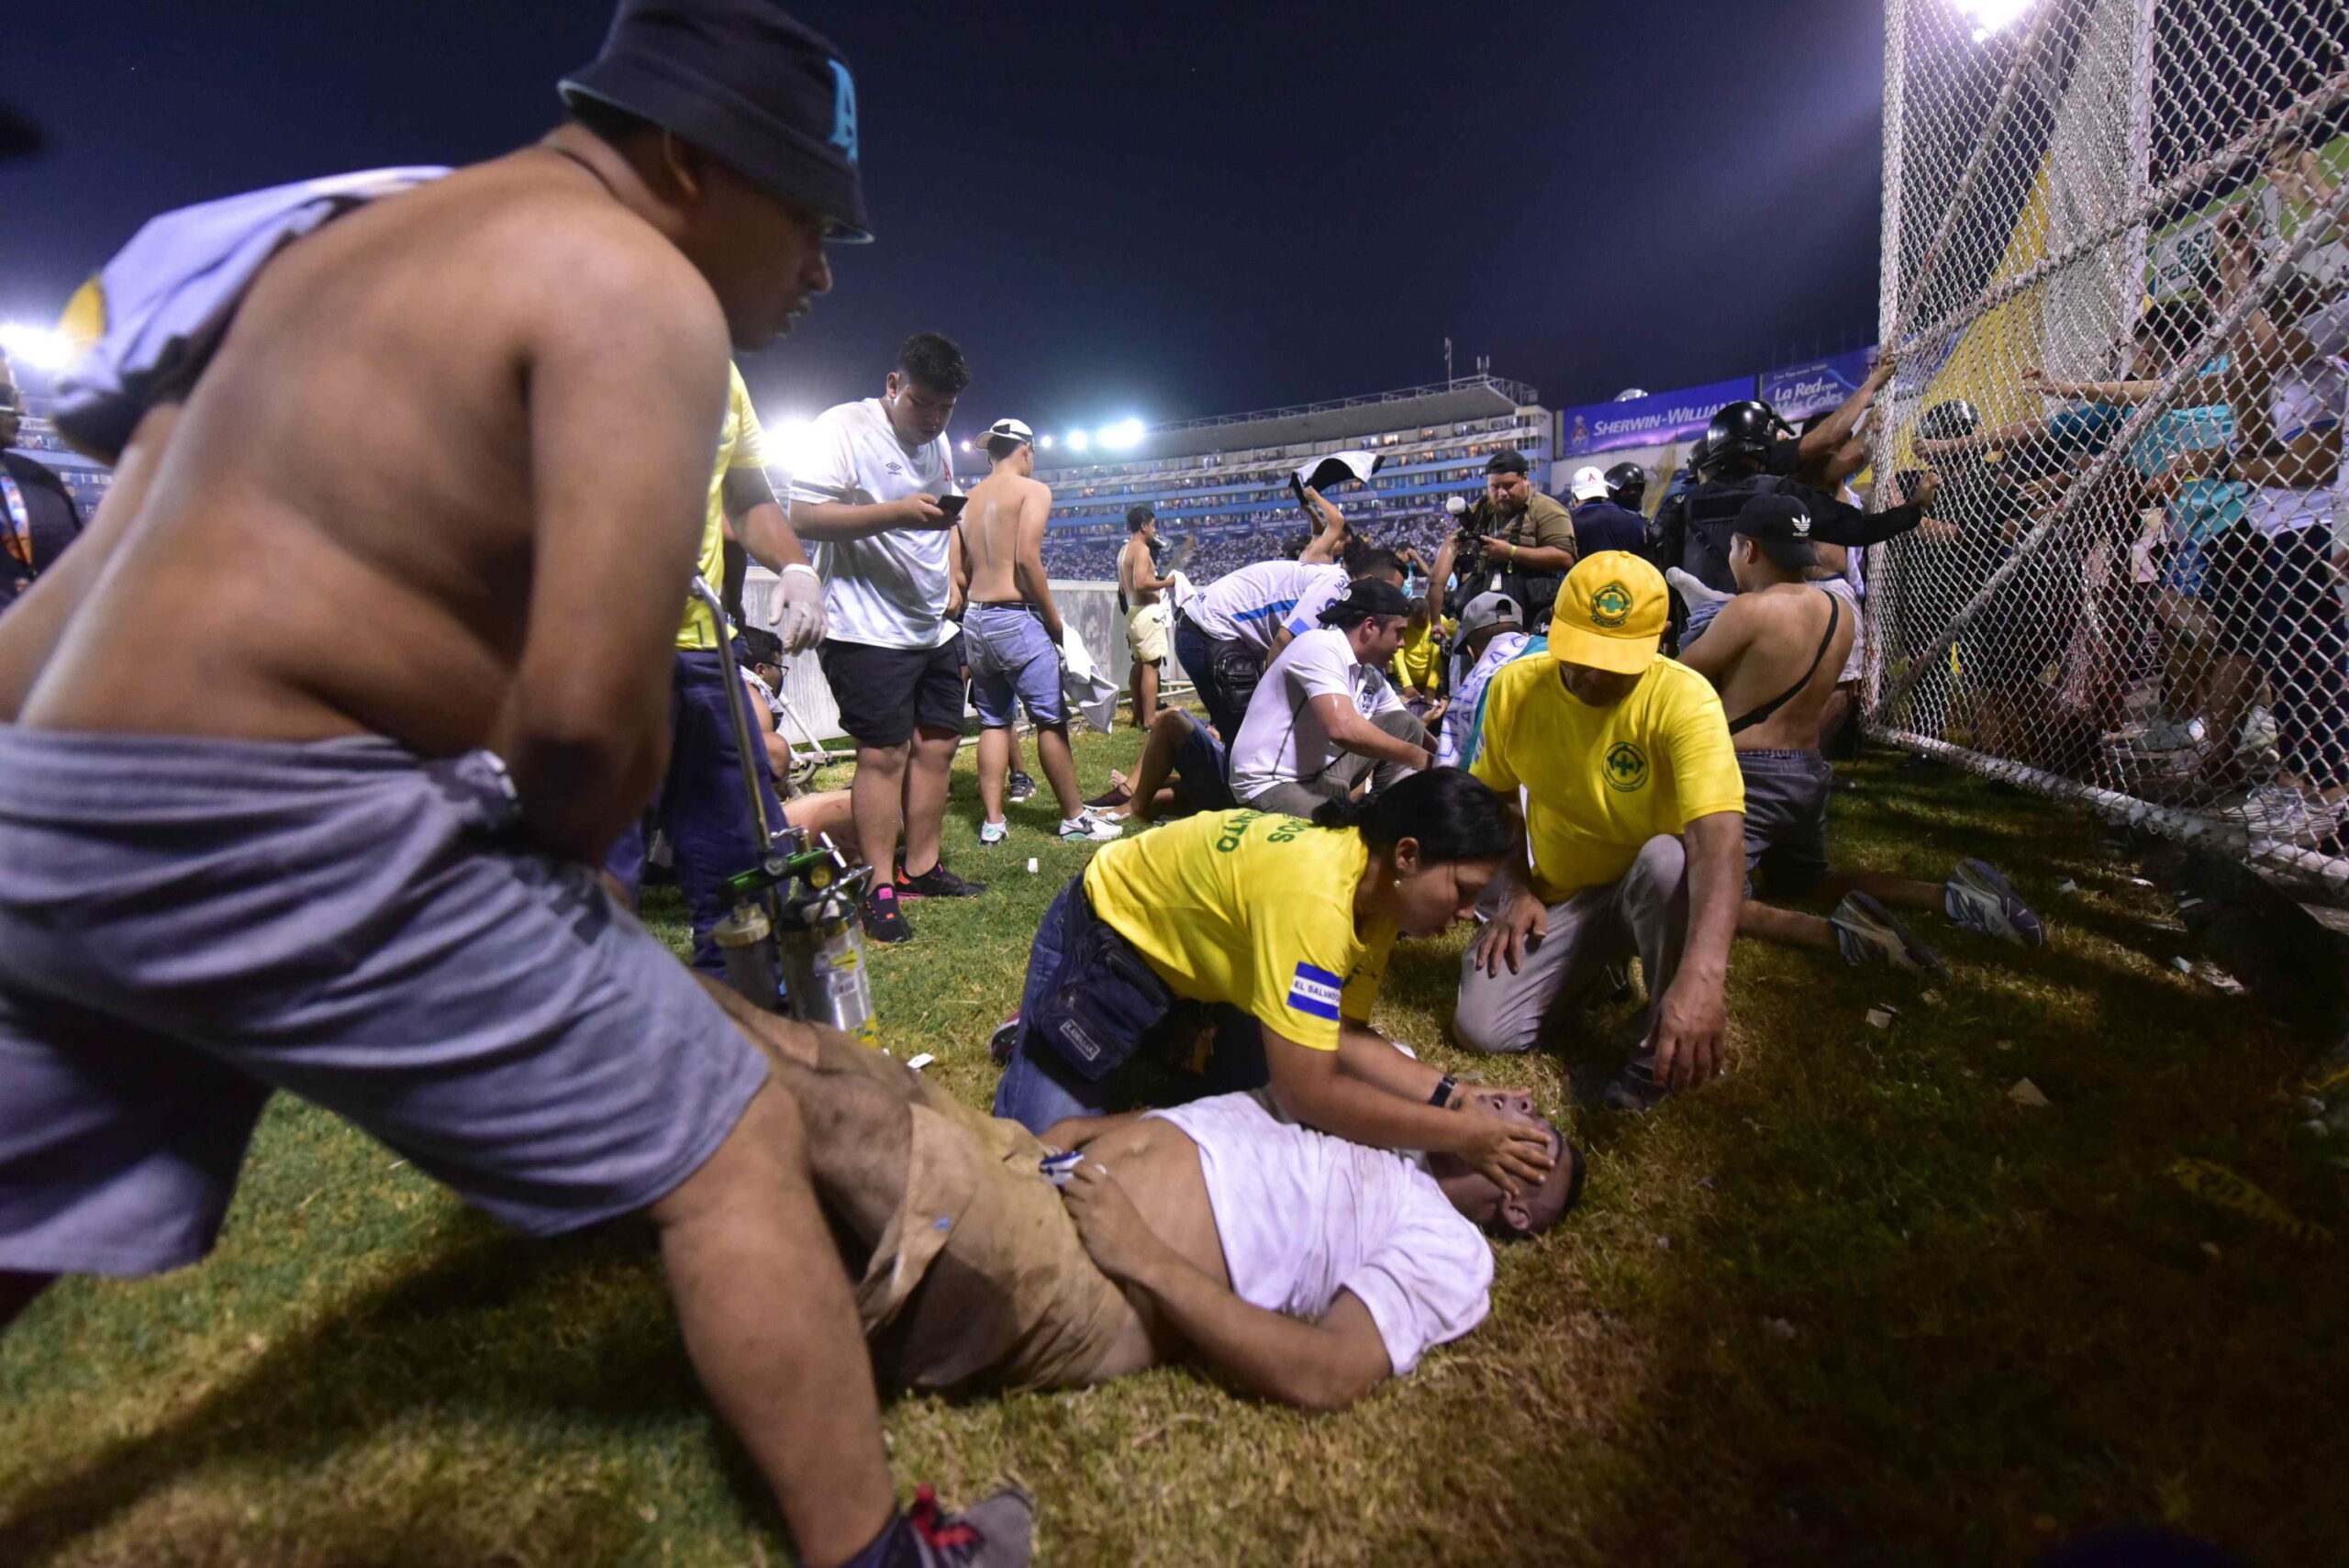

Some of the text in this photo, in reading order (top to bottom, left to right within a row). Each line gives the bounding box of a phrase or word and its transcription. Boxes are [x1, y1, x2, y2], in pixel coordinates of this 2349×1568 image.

[1775, 387, 1793, 402] La
[1795, 377, 1822, 398] Red
[1806, 391, 1843, 410] Goles
[1593, 400, 1742, 437] SHERWIN-WILLIA
[1294, 980, 1305, 991] EL
